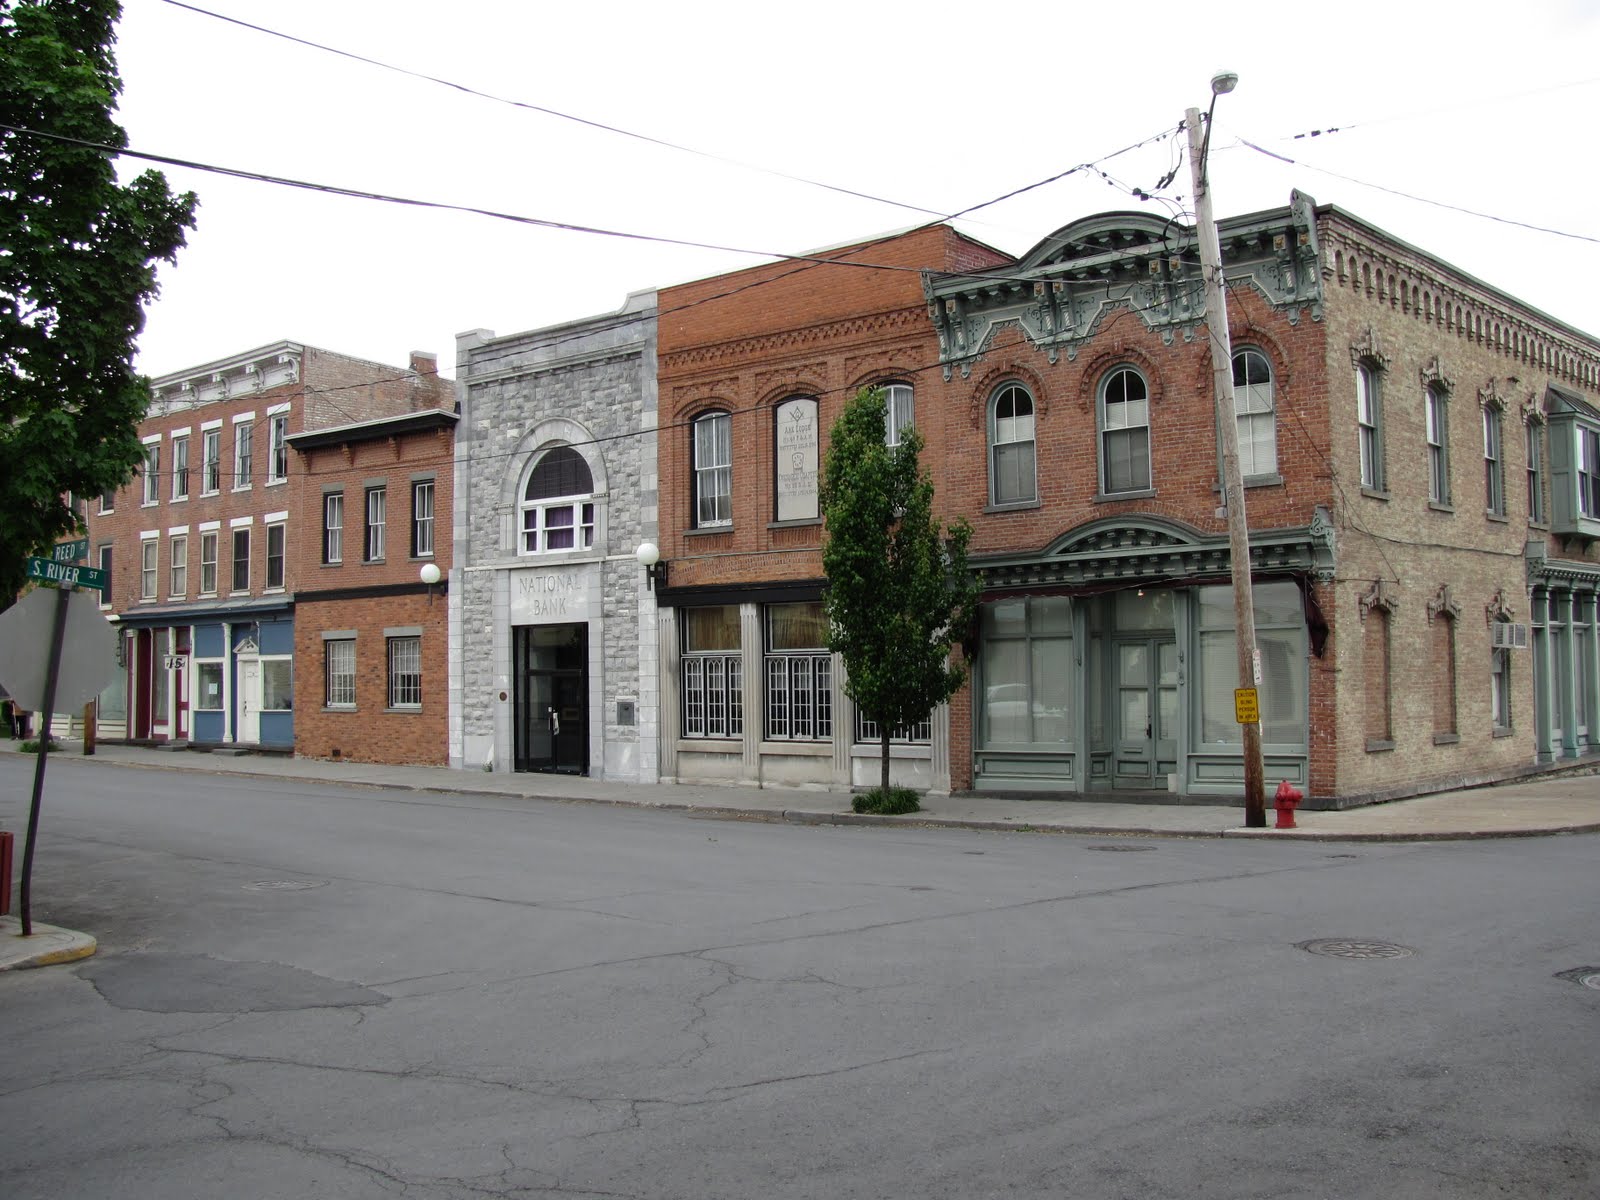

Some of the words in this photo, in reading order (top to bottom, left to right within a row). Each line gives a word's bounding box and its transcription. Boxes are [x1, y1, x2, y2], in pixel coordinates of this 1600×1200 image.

[55, 544, 75, 561] REED
[46, 564, 80, 582] RIVER
[89, 570, 98, 579] ST
[520, 574, 582, 593] NATIONAL
[534, 598, 567, 616] BANK
